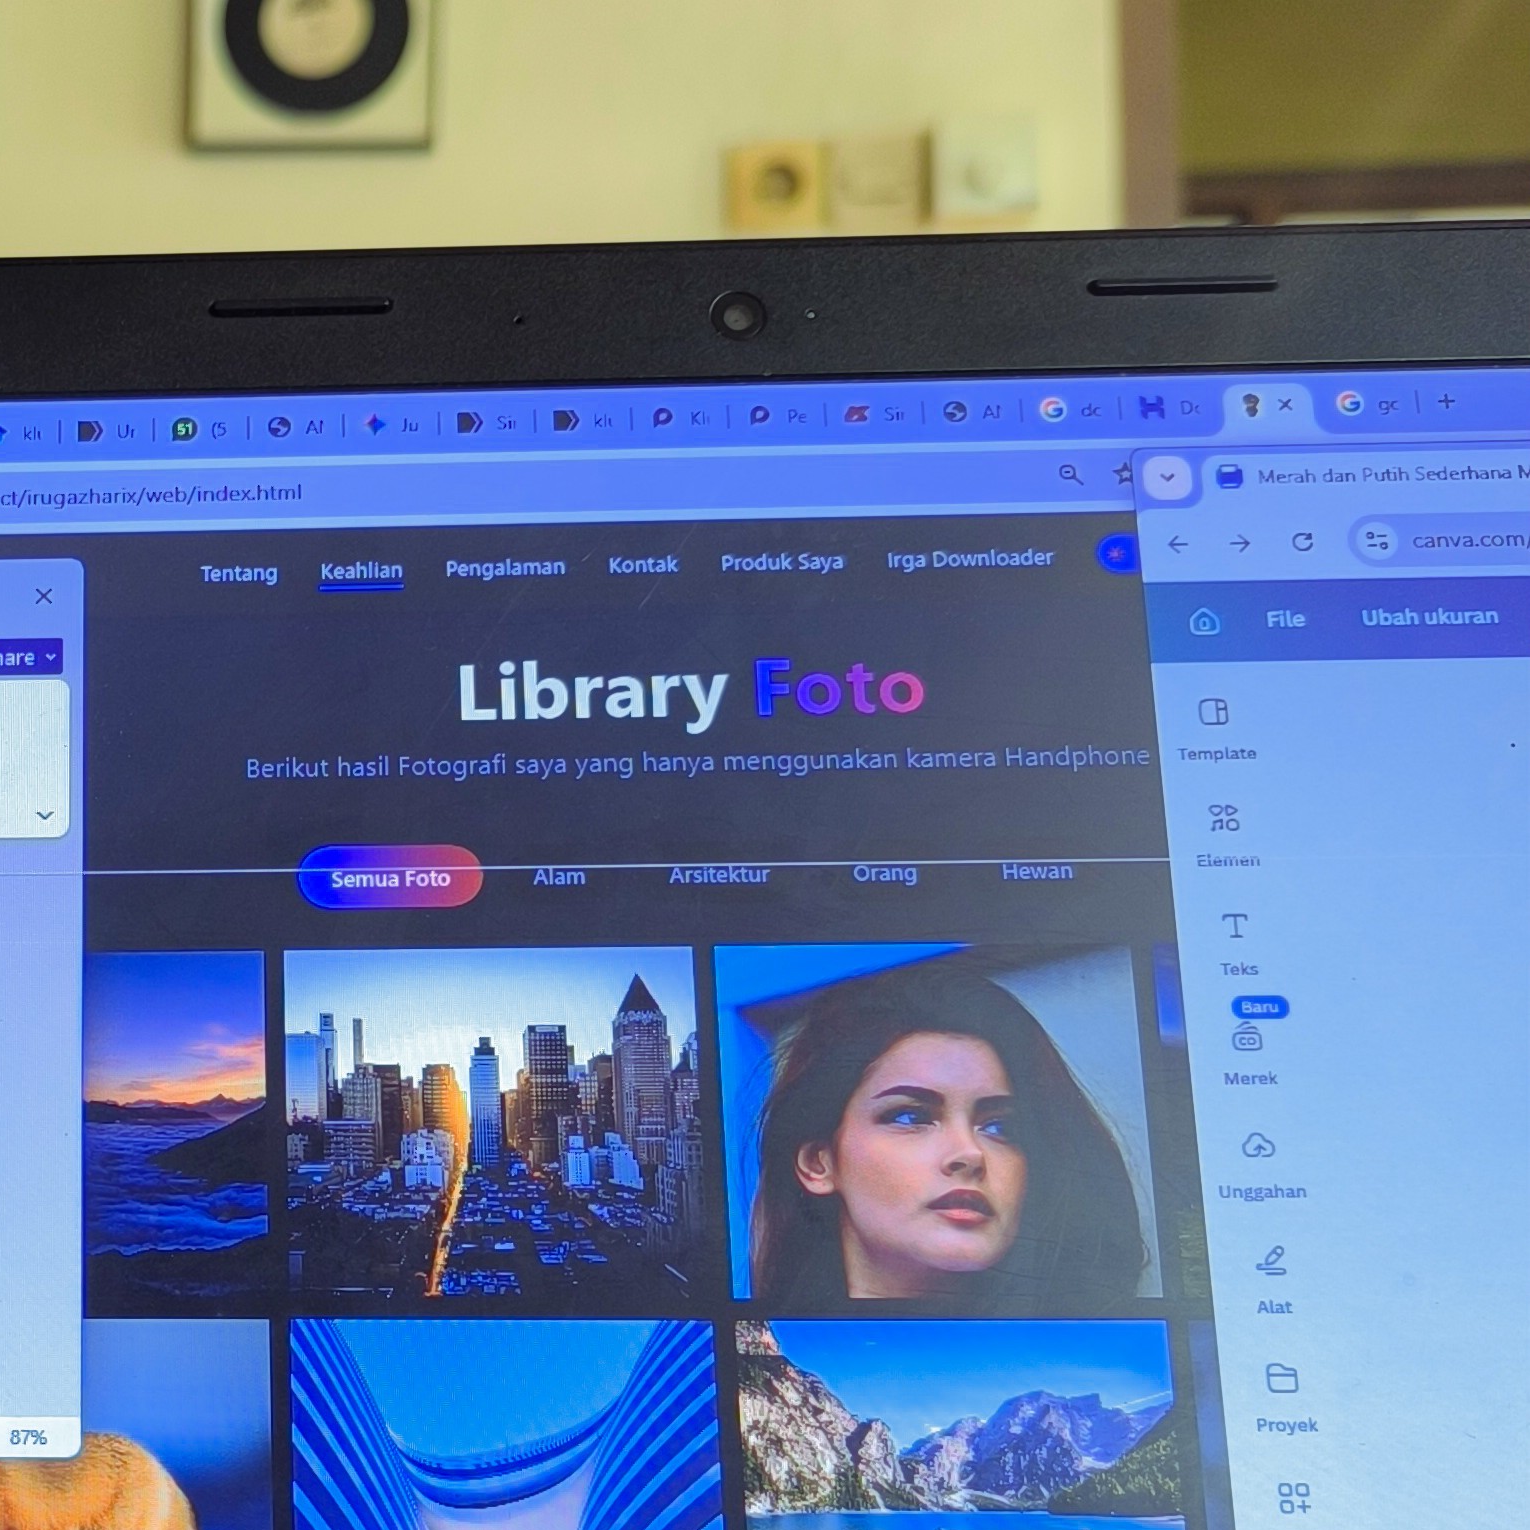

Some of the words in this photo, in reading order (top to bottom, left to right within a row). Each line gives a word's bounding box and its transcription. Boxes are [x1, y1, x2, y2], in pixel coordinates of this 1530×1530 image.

[787, 408, 807, 425] Pe
[1257, 468, 1317, 485] Merah
[1322, 467, 1356, 483] dan
[1362, 465, 1410, 483] Putih
[1415, 464, 1512, 482] Sederhana
[446, 558, 566, 581] Pengalaman
[608, 554, 679, 575] Kontak
[721, 552, 793, 573] Produk
[798, 551, 845, 575] Saya
[887, 551, 927, 572] Irga
[933, 548, 1054, 569] Downloader
[200, 563, 278, 586] Tentang
[320, 561, 403, 580] Keahlian
[1266, 609, 1307, 628] File
[1361, 607, 1419, 627] Ubah
[1424, 608, 1499, 626] ukuran
[458, 659, 730, 735] Library
[754, 656, 926, 718] Foto
[245, 756, 329, 779] Berikut
[337, 754, 389, 777] hasil
[399, 753, 507, 782] Fotografi
[515, 757, 567, 780] saya
[575, 756, 634, 780] yang
[642, 750, 715, 778] hanya
[723, 747, 898, 777] menggunakan
[906, 747, 997, 770] kamera
[1004, 744, 1151, 773] Handphone
[1177, 746, 1257, 764] Template
[331, 870, 399, 889] Semua
[405, 869, 451, 888] Foto
[533, 866, 586, 886] Alam
[670, 864, 770, 885] Arsitektur
[852, 864, 918, 887] Orang
[1001, 862, 1074, 881] Hewan
[1220, 962, 1259, 977] Teks
[1241, 1000, 1279, 1014] Baru
[1223, 1070, 1279, 1086] Merek
[1218, 1183, 1308, 1203] Unggahan
[1256, 1299, 1293, 1315] Alat
[1256, 1416, 1319, 1436] Proyek
[8, 1429, 49, 1447] 87%
